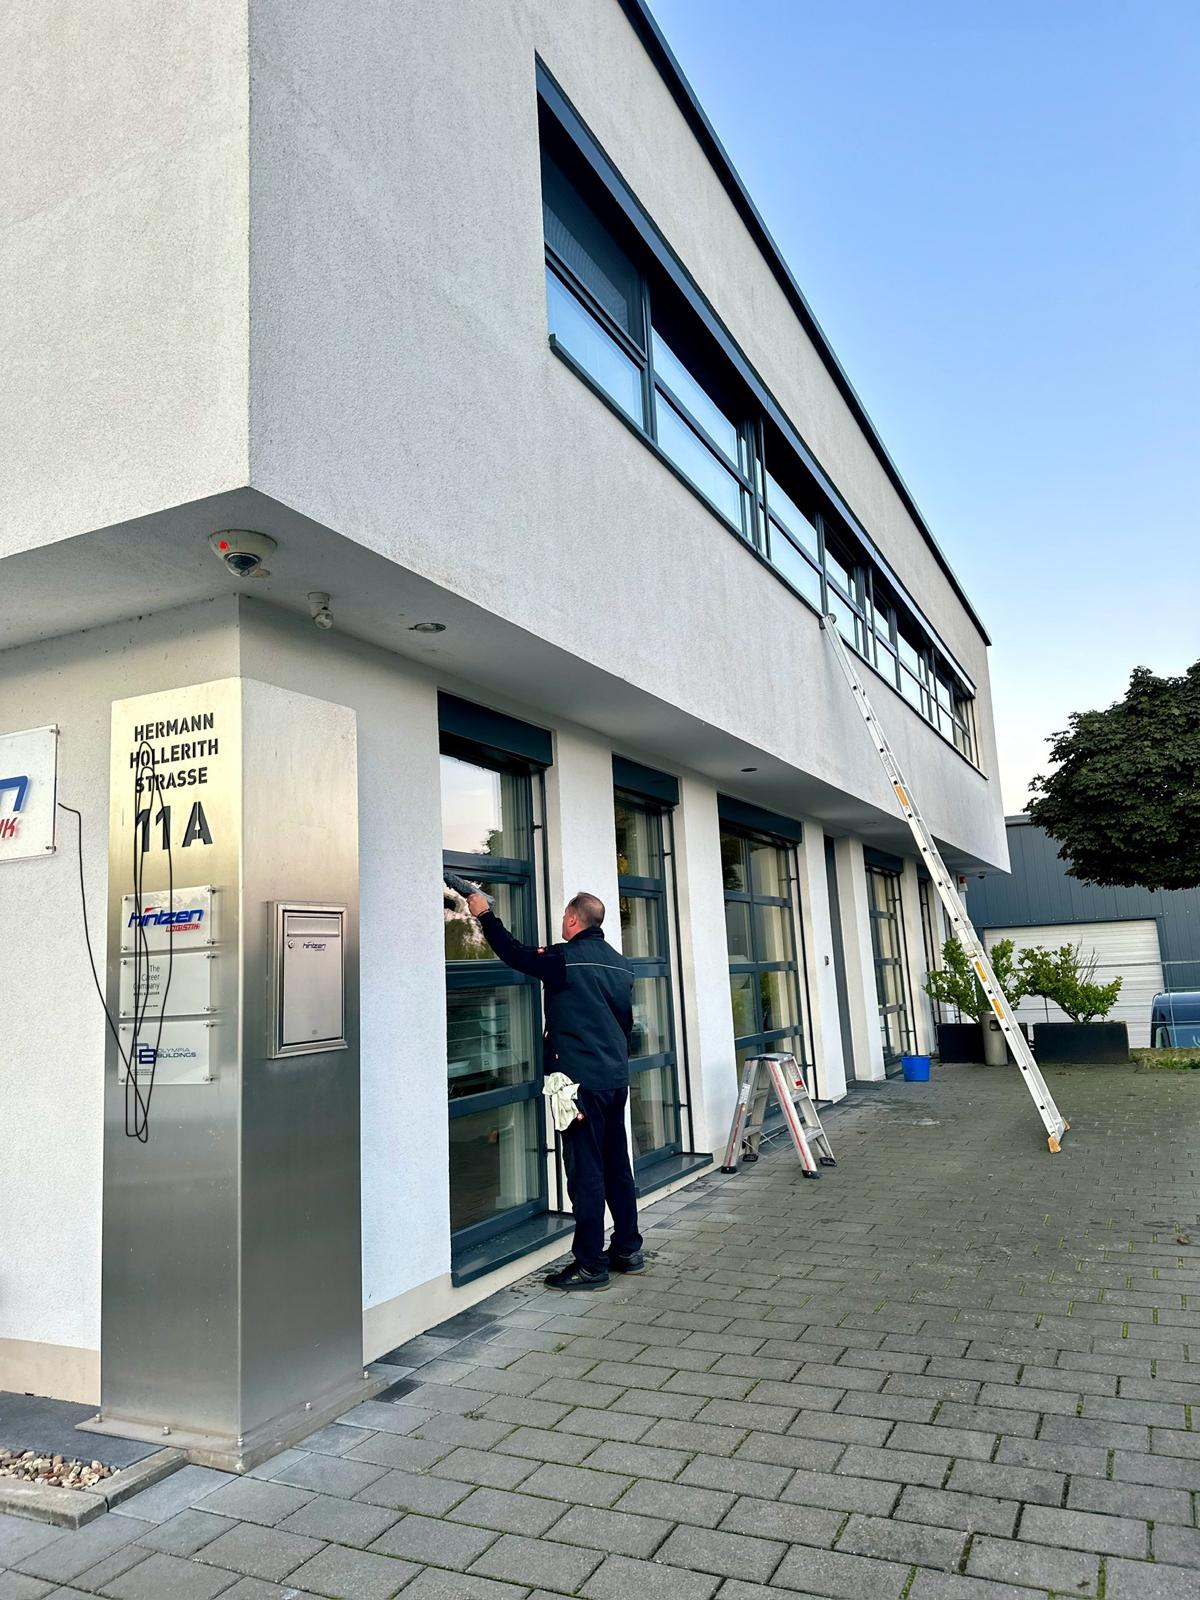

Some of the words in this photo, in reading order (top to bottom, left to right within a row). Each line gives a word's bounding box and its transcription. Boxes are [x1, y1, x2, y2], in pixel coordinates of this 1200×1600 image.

[134, 712, 214, 742] HERMANN
[129, 738, 219, 769] HOLLERITH
[135, 766, 208, 793] STRASSE
[136, 805, 171, 852] 11
[182, 801, 213, 848] A
[142, 973, 160, 982] Creer
[150, 964, 160, 973] The
